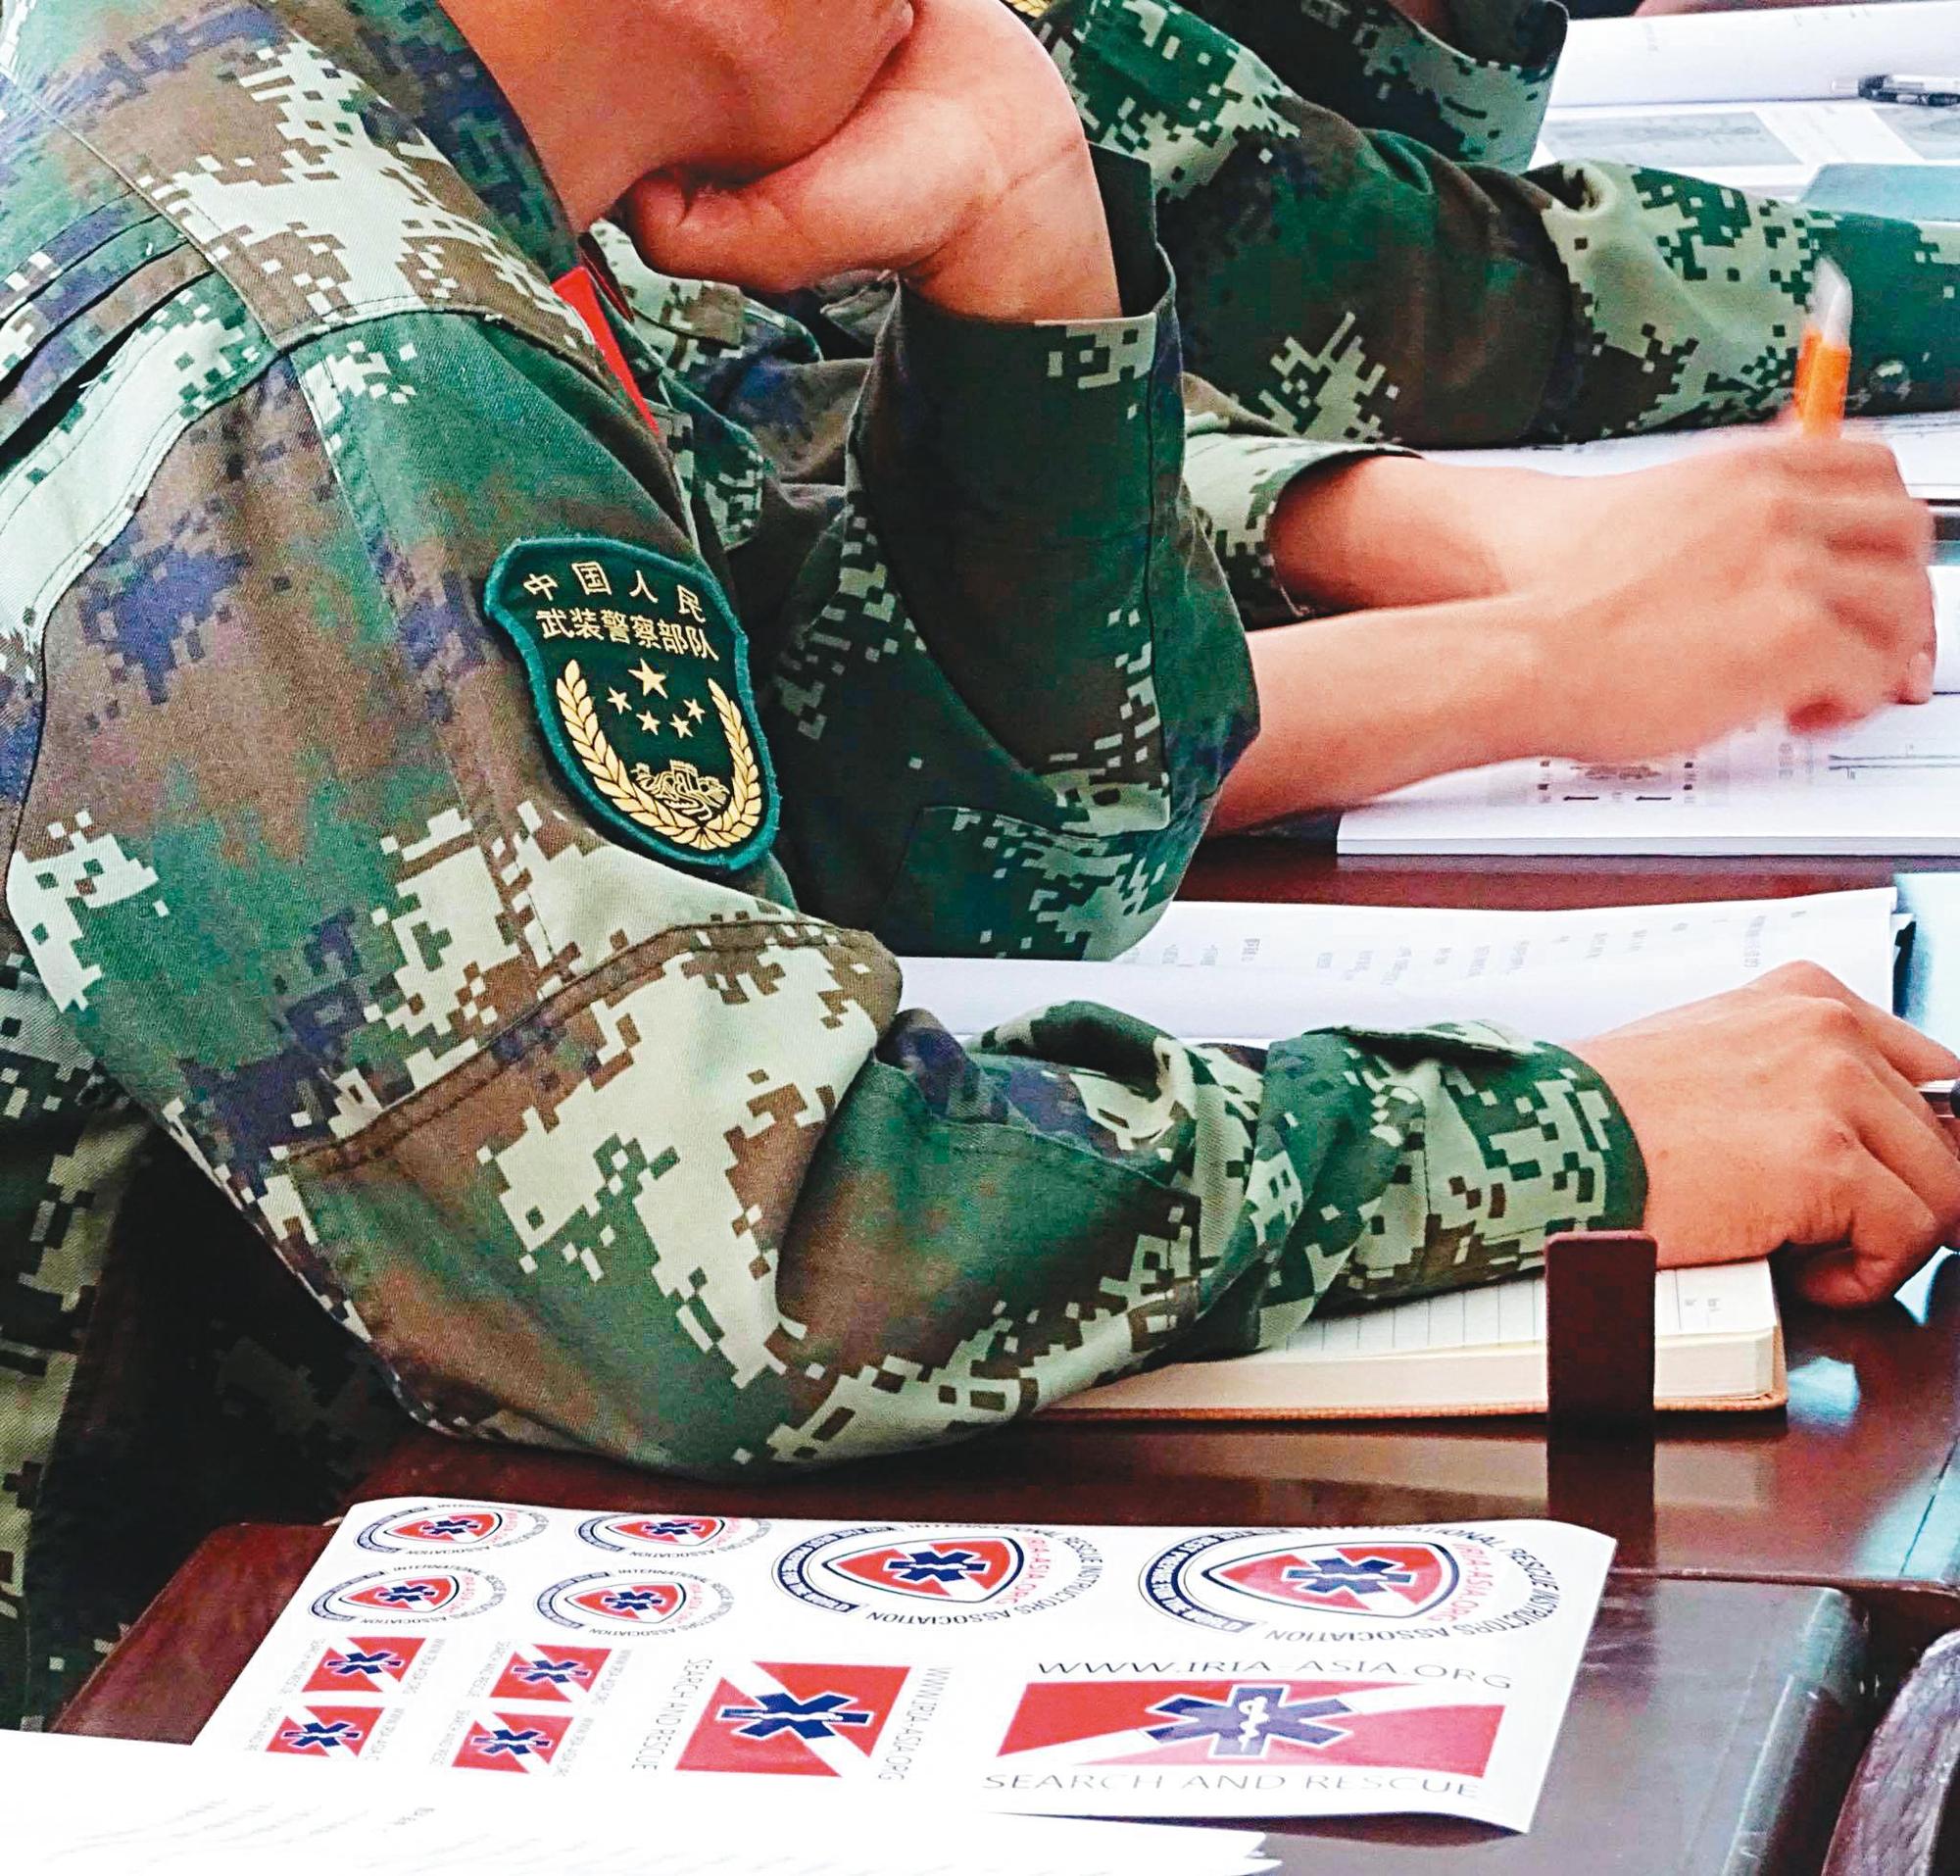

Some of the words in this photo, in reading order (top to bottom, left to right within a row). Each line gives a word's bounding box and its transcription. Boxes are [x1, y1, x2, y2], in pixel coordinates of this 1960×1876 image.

[522, 561, 707, 623] 中国人民
[535, 608, 720, 662] 武装警察部队
[1500, 1547, 1560, 1592] RESCUE
[865, 1610, 1010, 1625] ASSOCIATION
[1454, 1587, 1561, 1635] INSTRUCTORS
[1265, 1627, 1450, 1643] ASSOCIATION
[655, 1701, 690, 1726] AND
[631, 1728, 676, 1771] RESCUE
[982, 1772, 1164, 1790] SEARCH
[1181, 1772, 1286, 1790] AND
[1304, 1772, 1481, 1799] RESCUE
